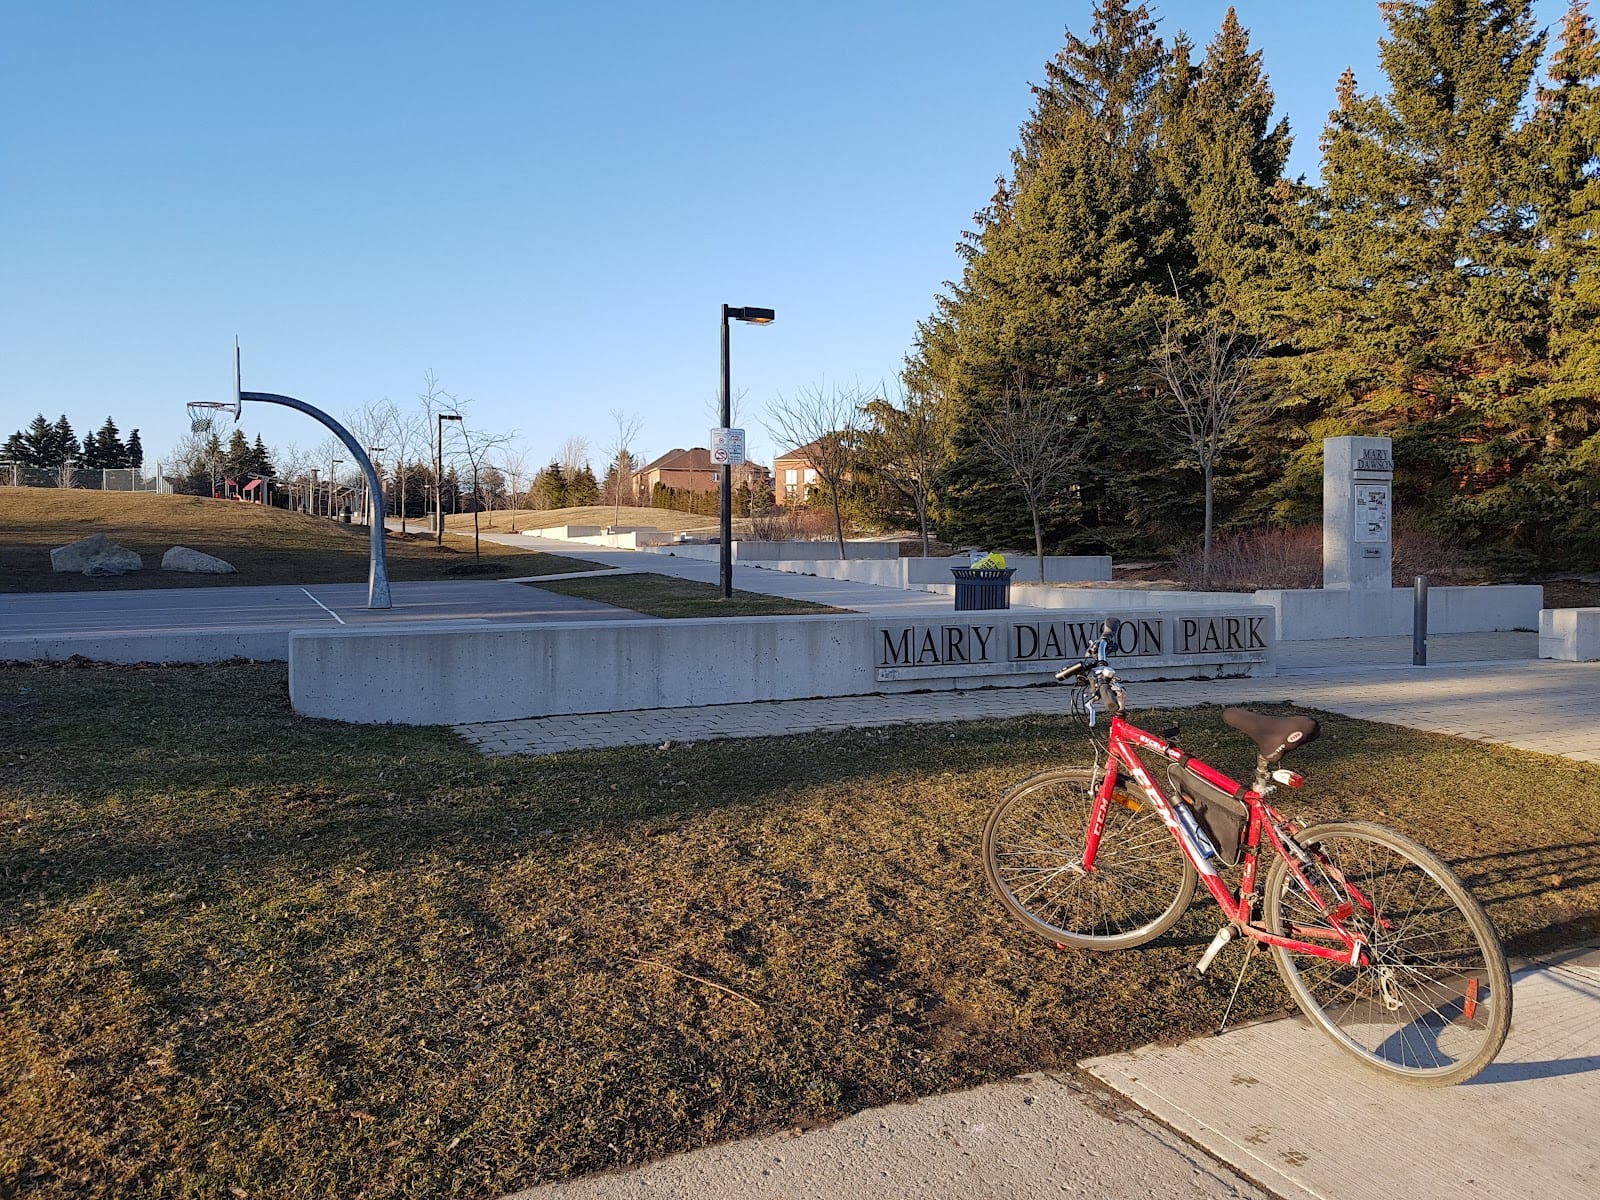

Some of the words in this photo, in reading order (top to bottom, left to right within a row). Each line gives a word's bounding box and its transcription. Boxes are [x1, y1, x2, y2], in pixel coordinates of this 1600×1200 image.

[1358, 460, 1393, 469] DAWSON
[1363, 449, 1388, 460] MARY
[880, 627, 995, 665] MARY
[1013, 620, 1163, 659] DAWON
[1181, 617, 1268, 651] PARK
[1139, 735, 1181, 759] EXCELSOR
[1093, 797, 1109, 836] CCM
